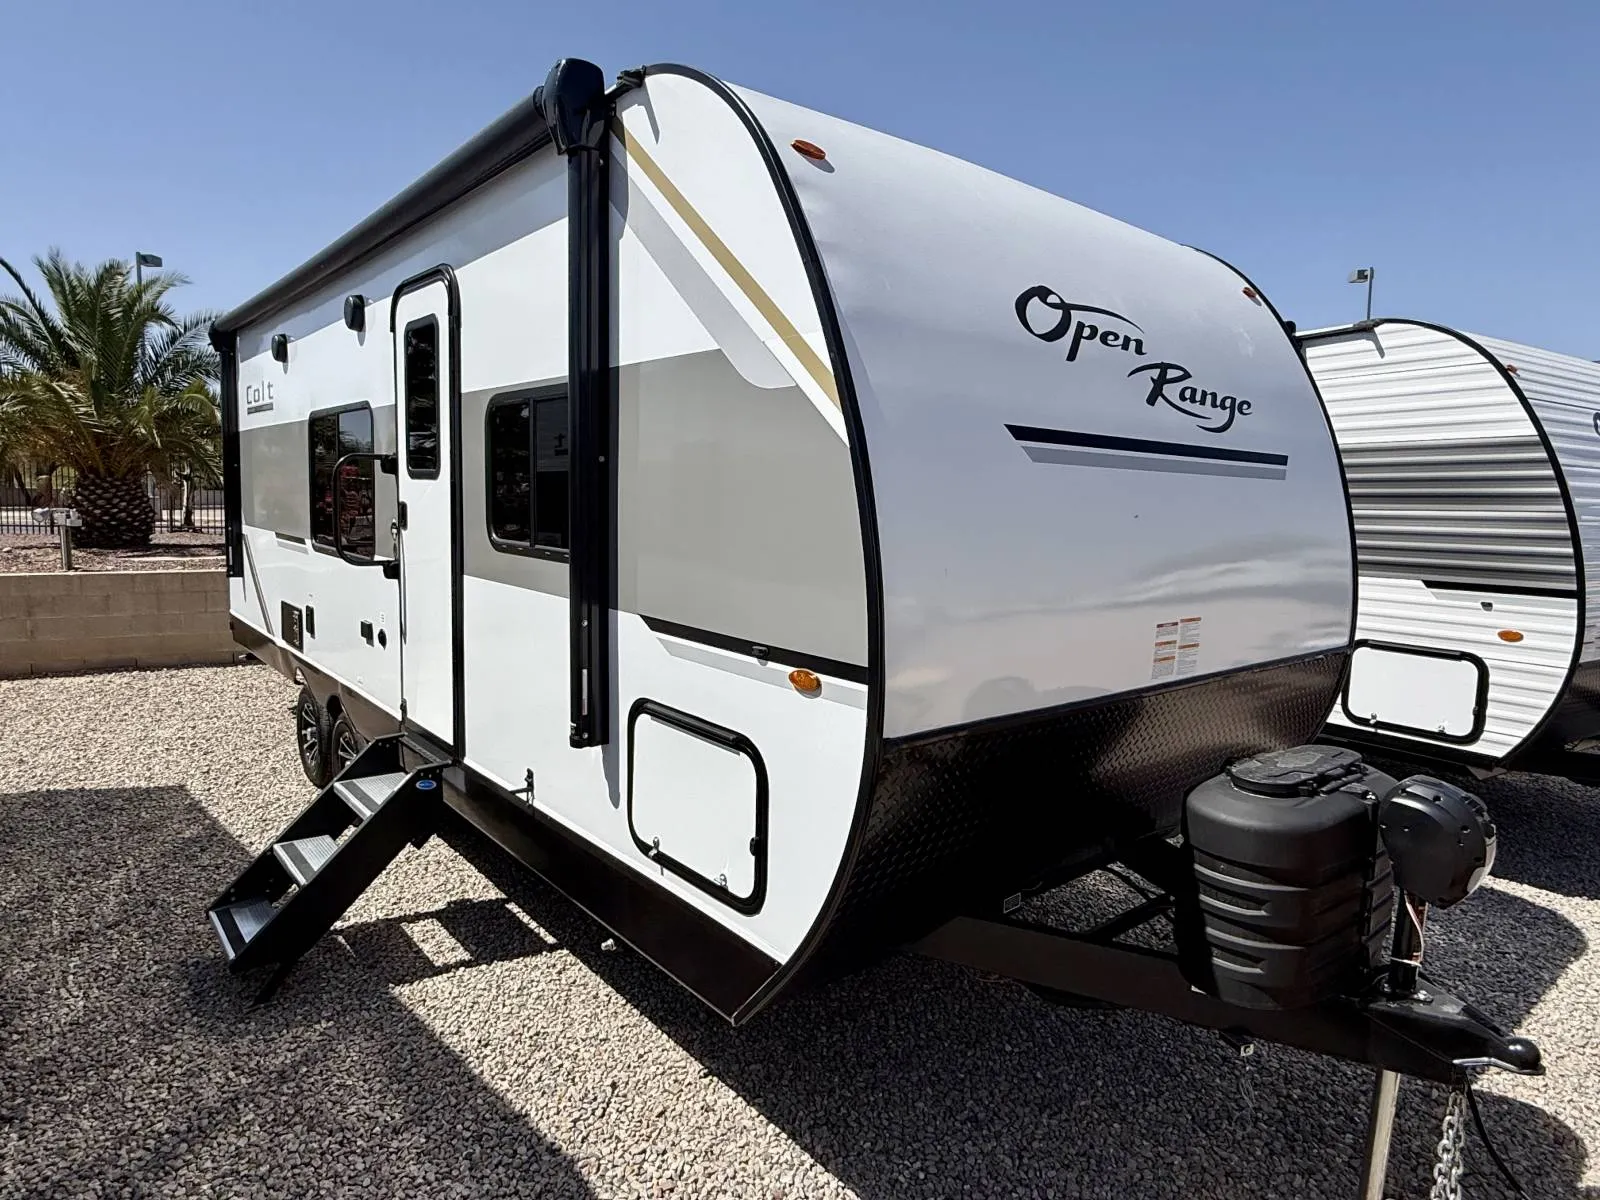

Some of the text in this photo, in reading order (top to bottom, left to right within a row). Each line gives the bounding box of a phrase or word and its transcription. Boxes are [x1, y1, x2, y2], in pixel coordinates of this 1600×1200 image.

[1014, 285, 1147, 362] Open
[246, 380, 274, 405] Colt
[1127, 361, 1253, 433] Range
